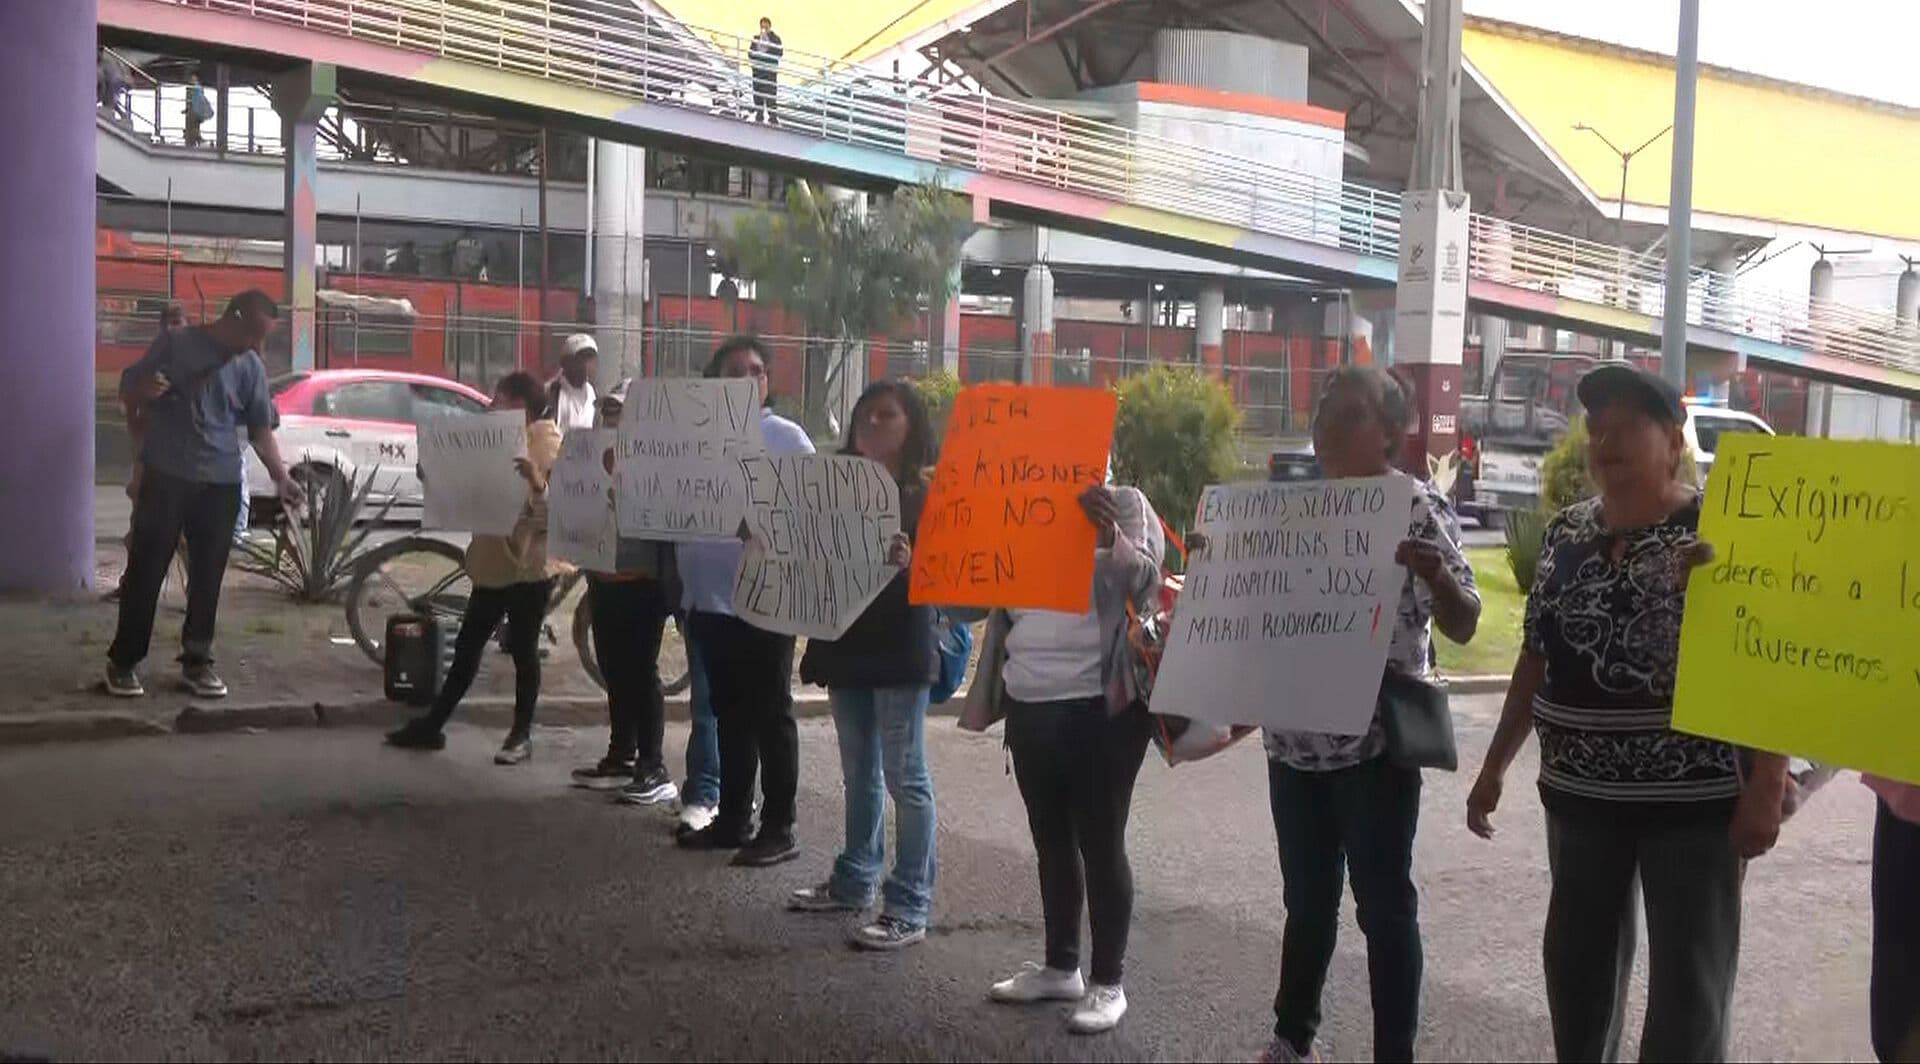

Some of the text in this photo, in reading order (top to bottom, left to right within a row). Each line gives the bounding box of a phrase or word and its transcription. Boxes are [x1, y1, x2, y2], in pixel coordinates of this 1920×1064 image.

[1003, 495, 1056, 527] NO
[1344, 528, 1370, 557] EN
[1712, 543, 1820, 593] dereho
[1849, 578, 1862, 600] a
